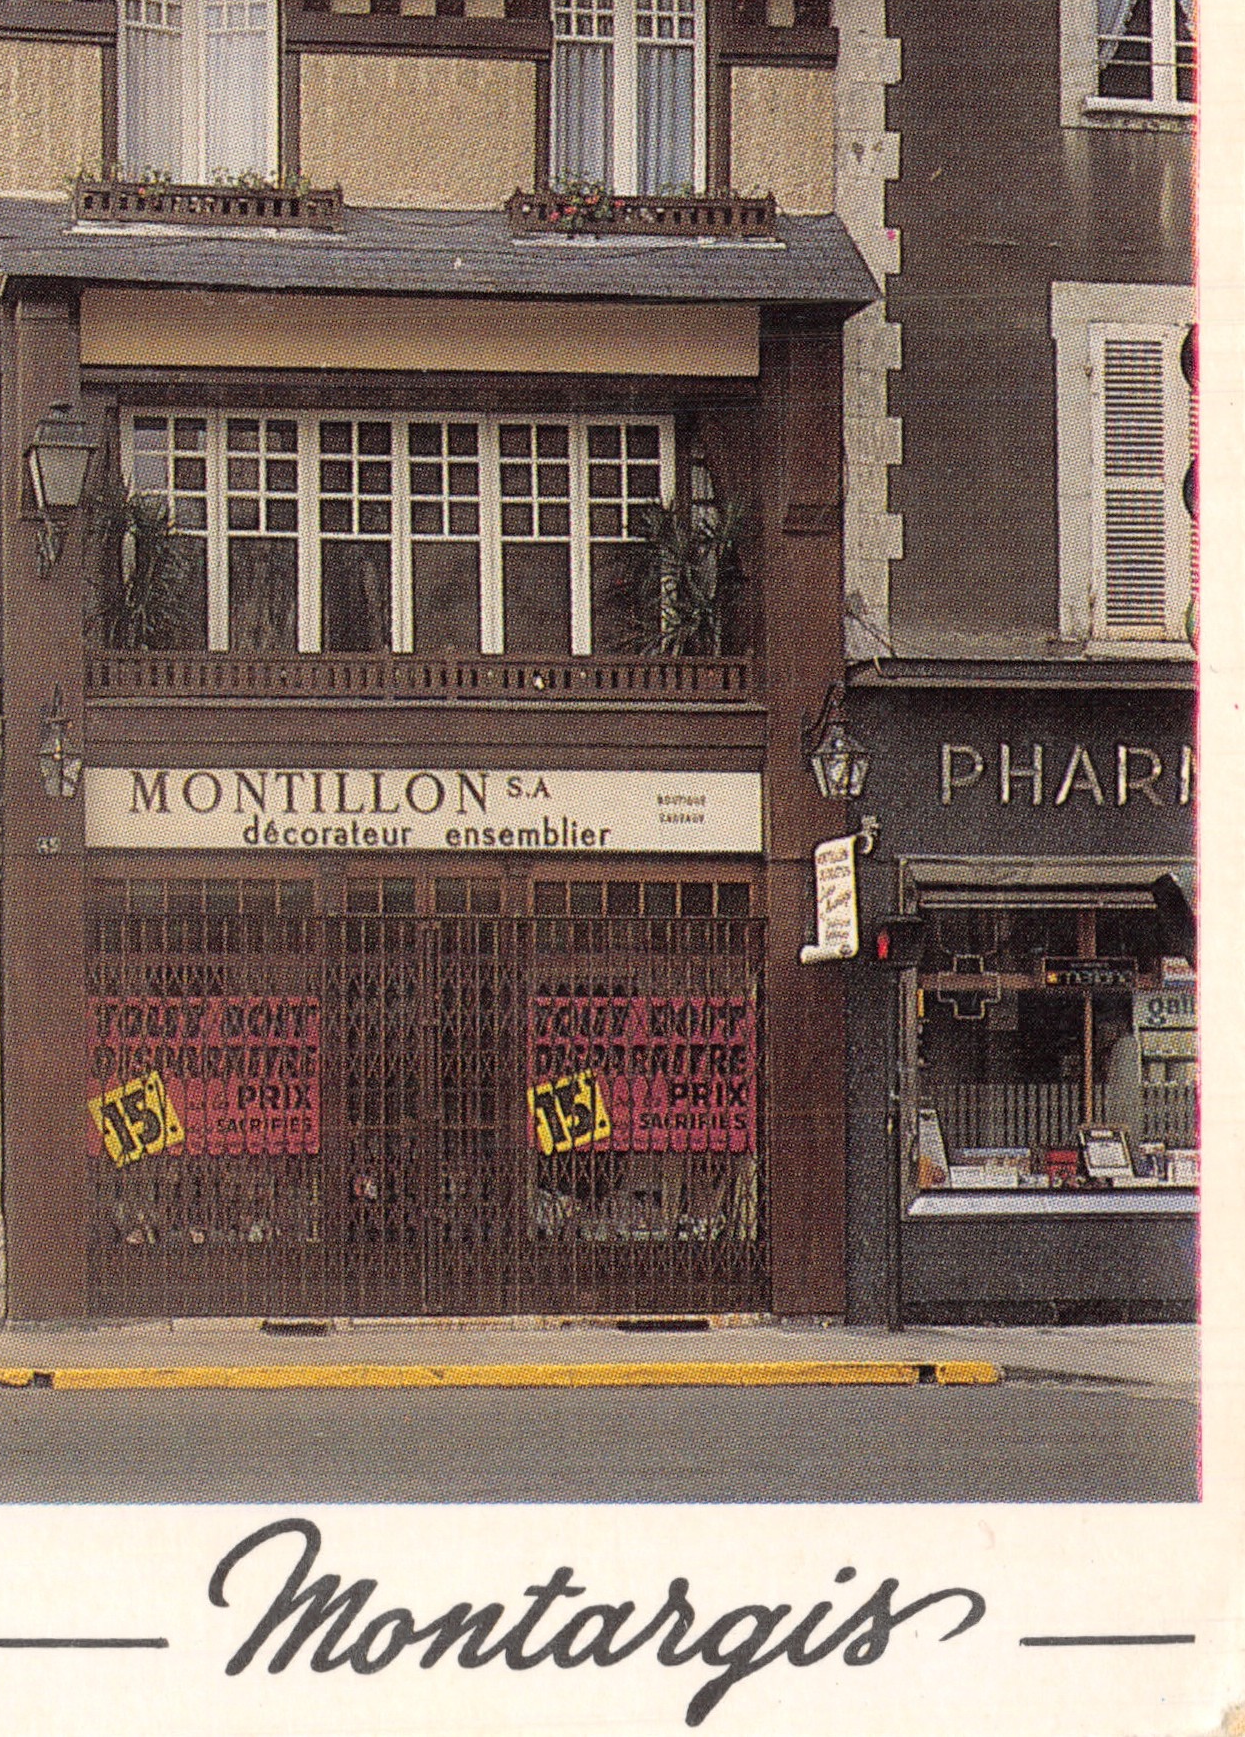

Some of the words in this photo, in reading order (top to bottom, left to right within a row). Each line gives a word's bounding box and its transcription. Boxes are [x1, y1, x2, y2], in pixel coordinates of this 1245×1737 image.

[128, 770, 492, 815] MONTILLON
[242, 813, 412, 848] décorateur
[445, 816, 611, 849] ensemblier
[237, 1083, 313, 1110] PRIX
[669, 1081, 749, 1108] PRIX
